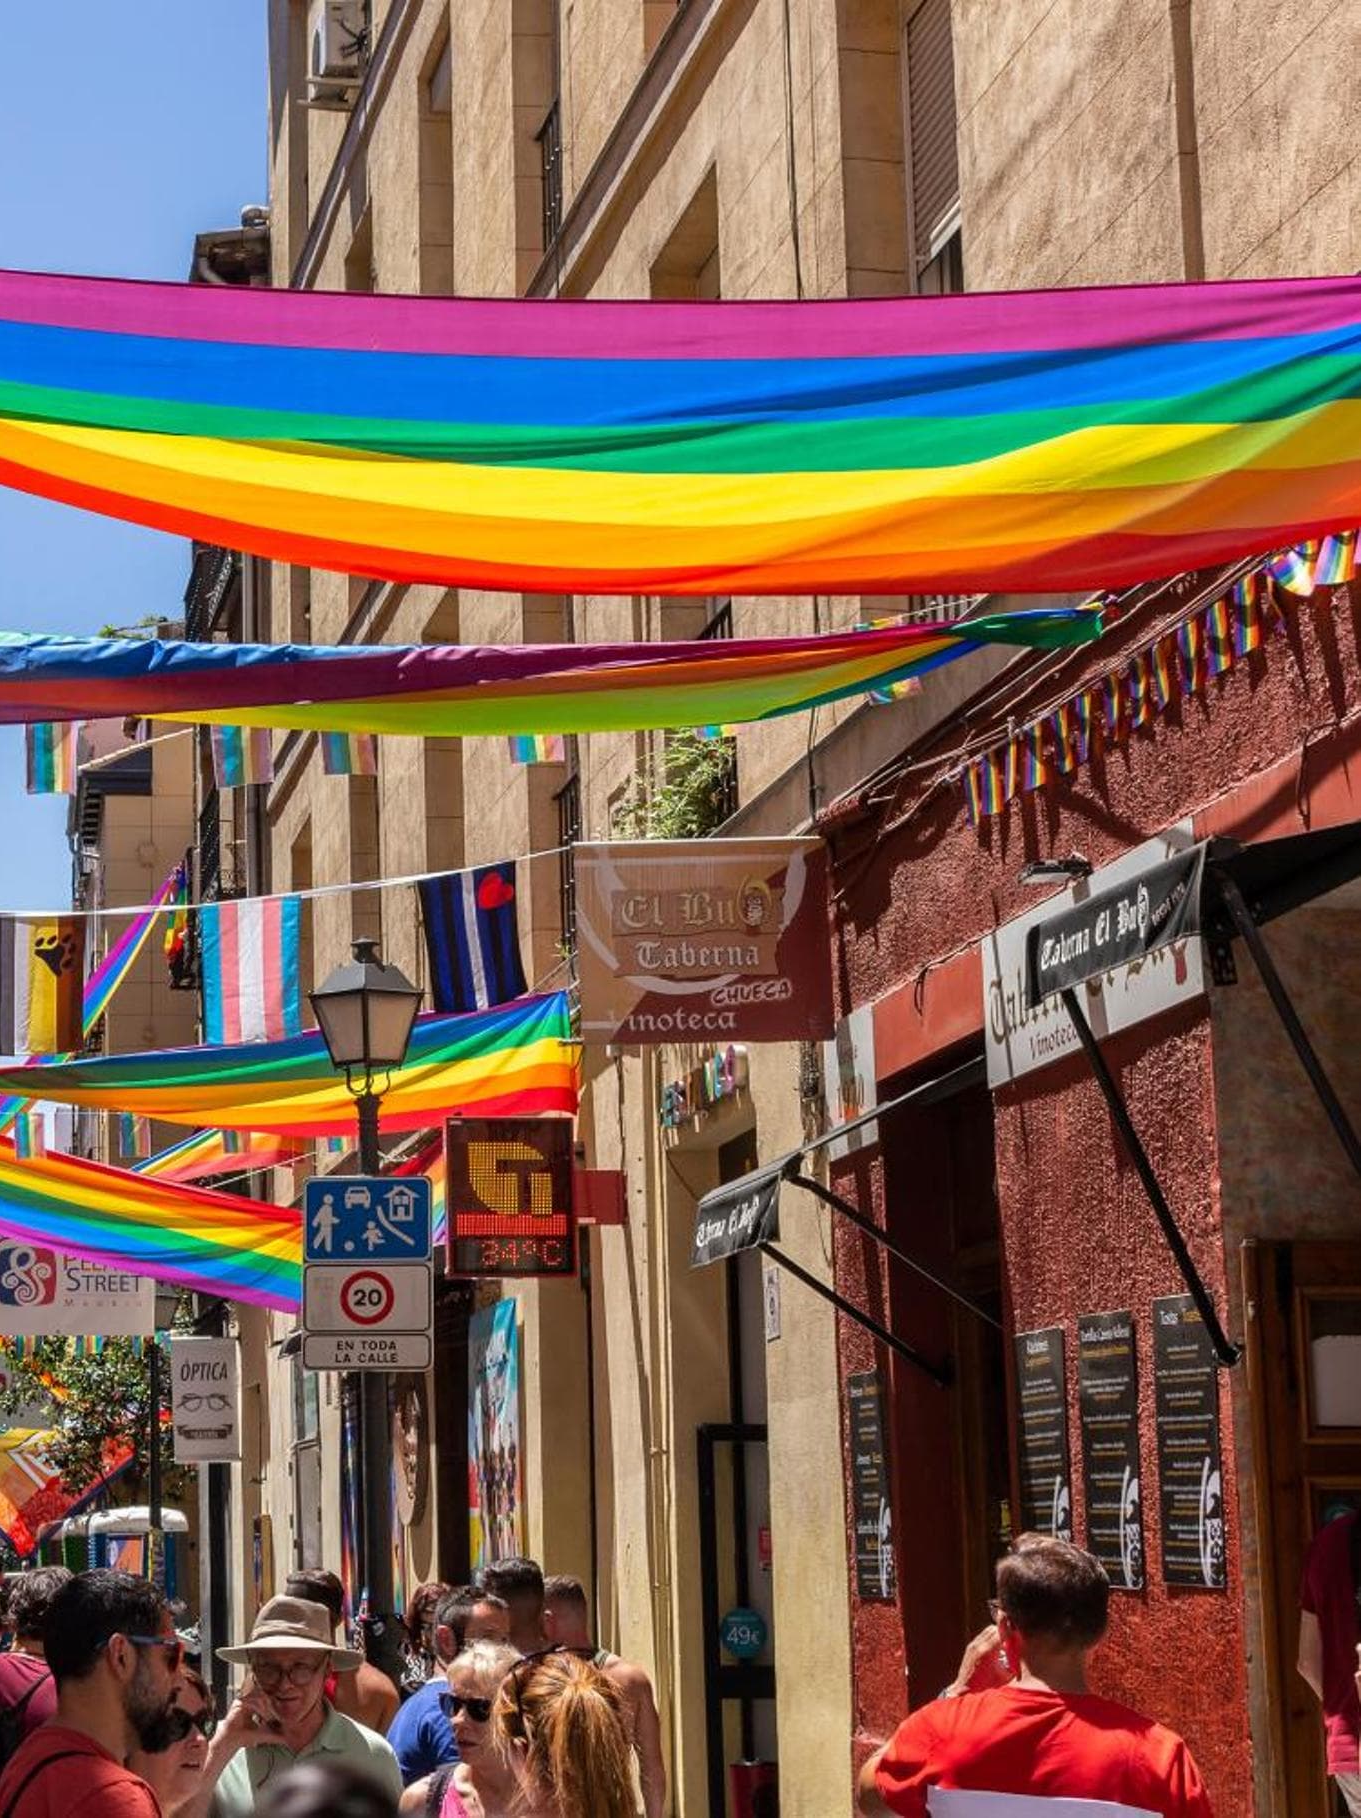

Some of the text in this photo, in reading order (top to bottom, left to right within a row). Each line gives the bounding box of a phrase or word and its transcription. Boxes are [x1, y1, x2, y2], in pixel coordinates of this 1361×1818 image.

[621, 895, 664, 929] El
[635, 940, 760, 969] Taberna
[352, 1289, 383, 1306] 20
[336, 1340, 397, 1351] EN TODA
[335, 1353, 398, 1364] LA CALLE
[180, 1359, 228, 1381] ÓPTICA
